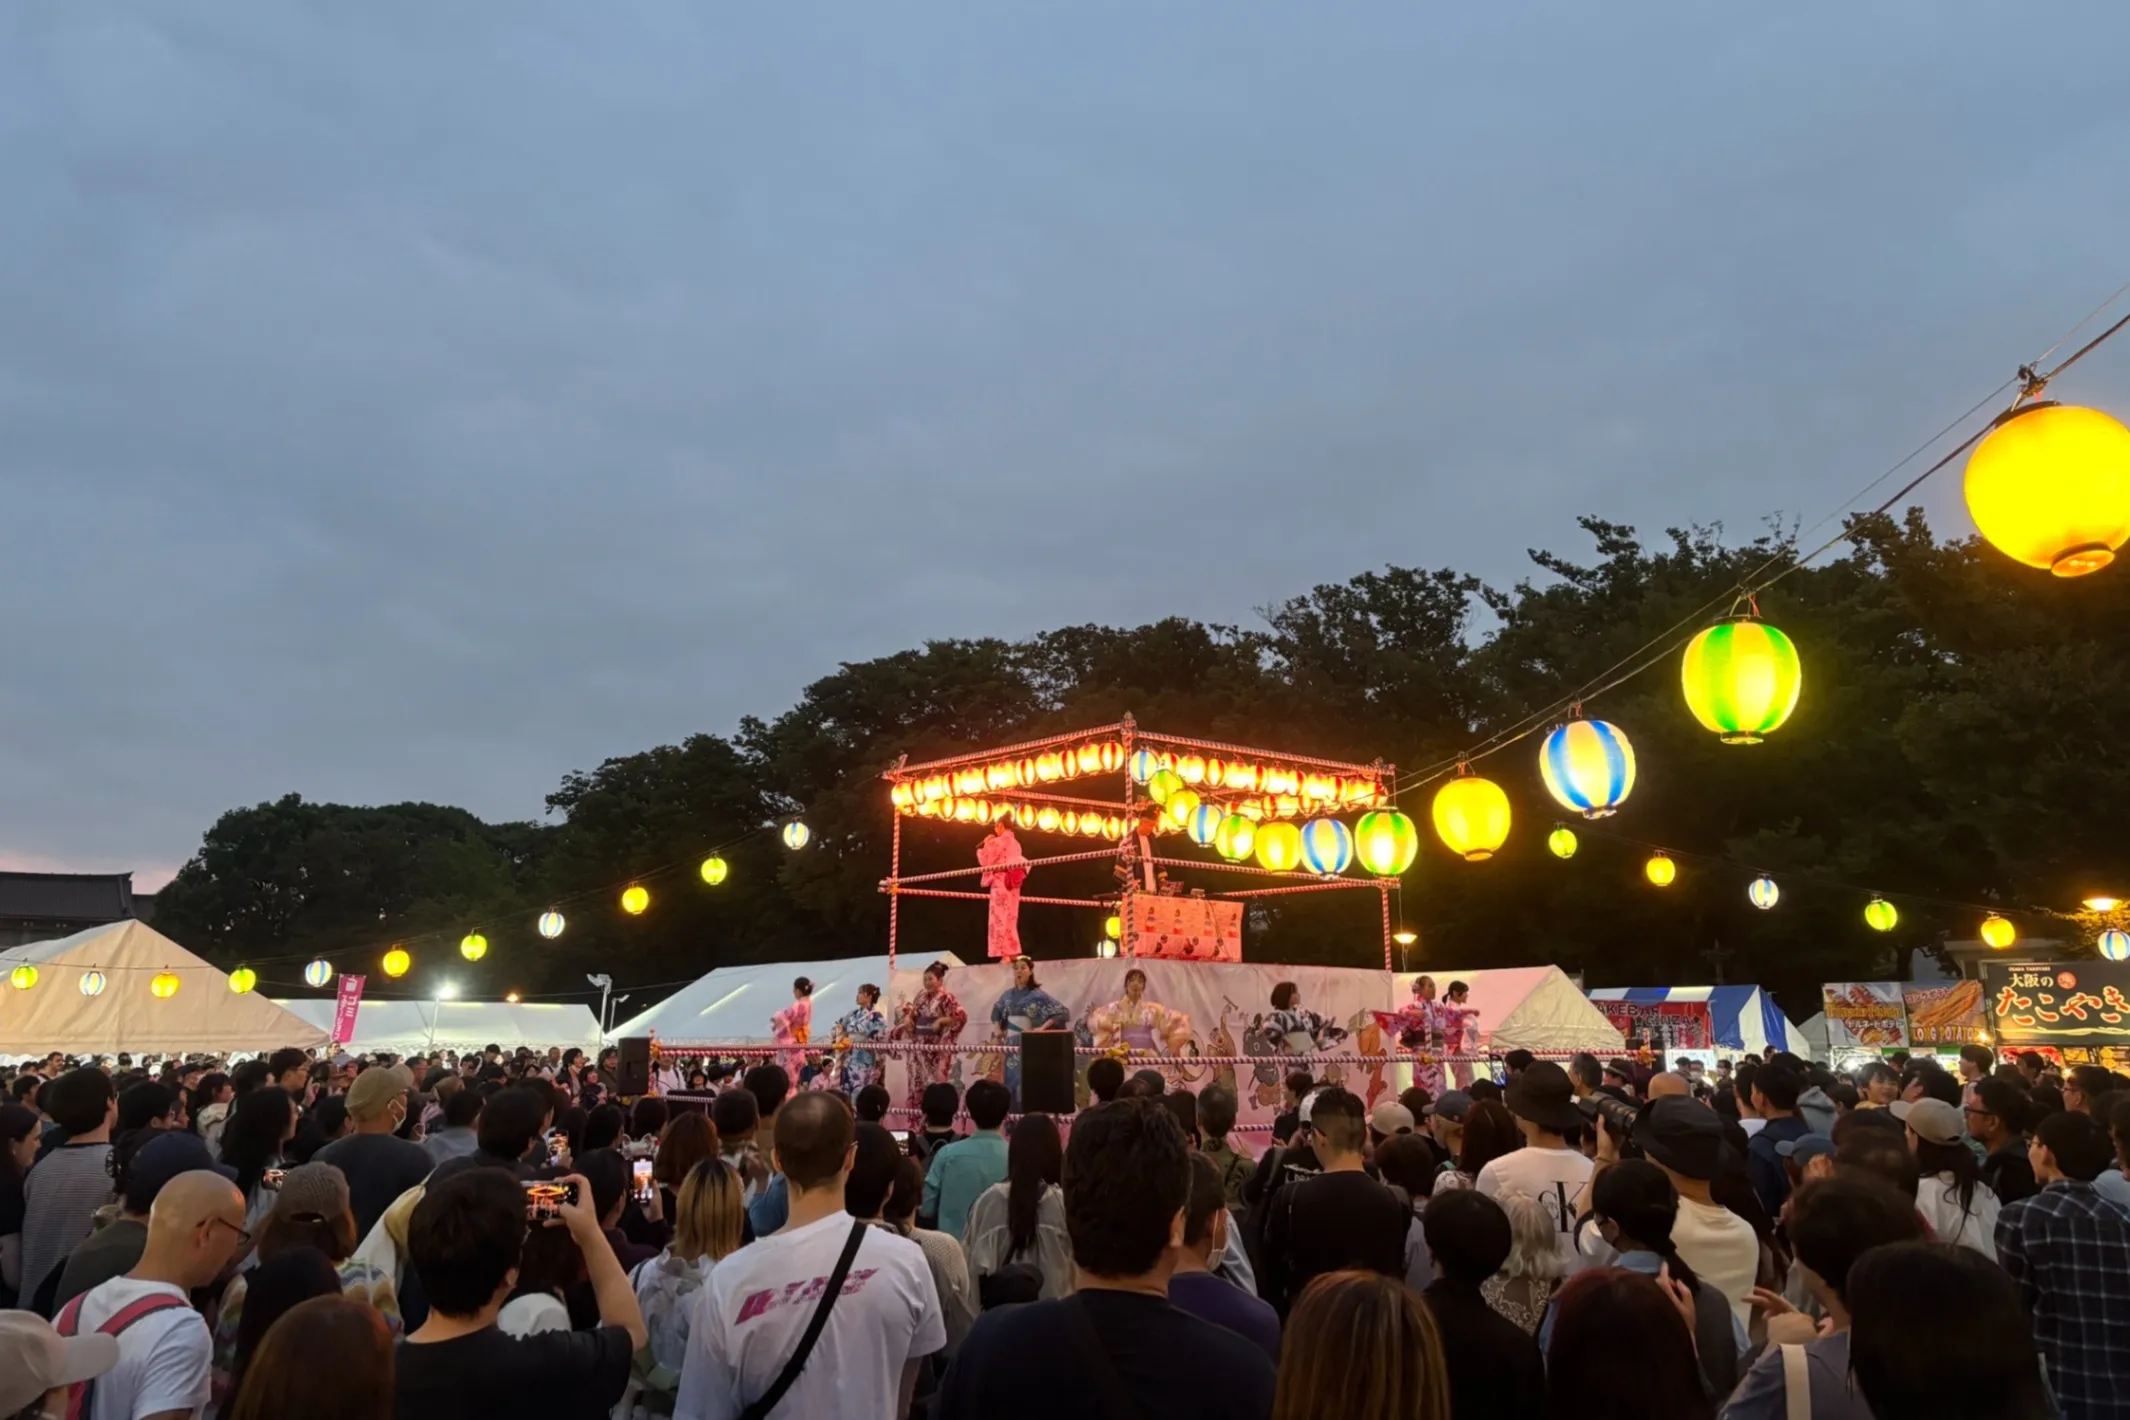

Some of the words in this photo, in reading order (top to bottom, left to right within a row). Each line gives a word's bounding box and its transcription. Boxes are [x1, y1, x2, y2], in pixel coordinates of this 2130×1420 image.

[2008, 972, 2054, 988] 大阪の
[1996, 986, 2130, 1026] たこやき
[1912, 1026, 1938, 1041] LONG
[1939, 1026, 1986, 1041] POTATO
